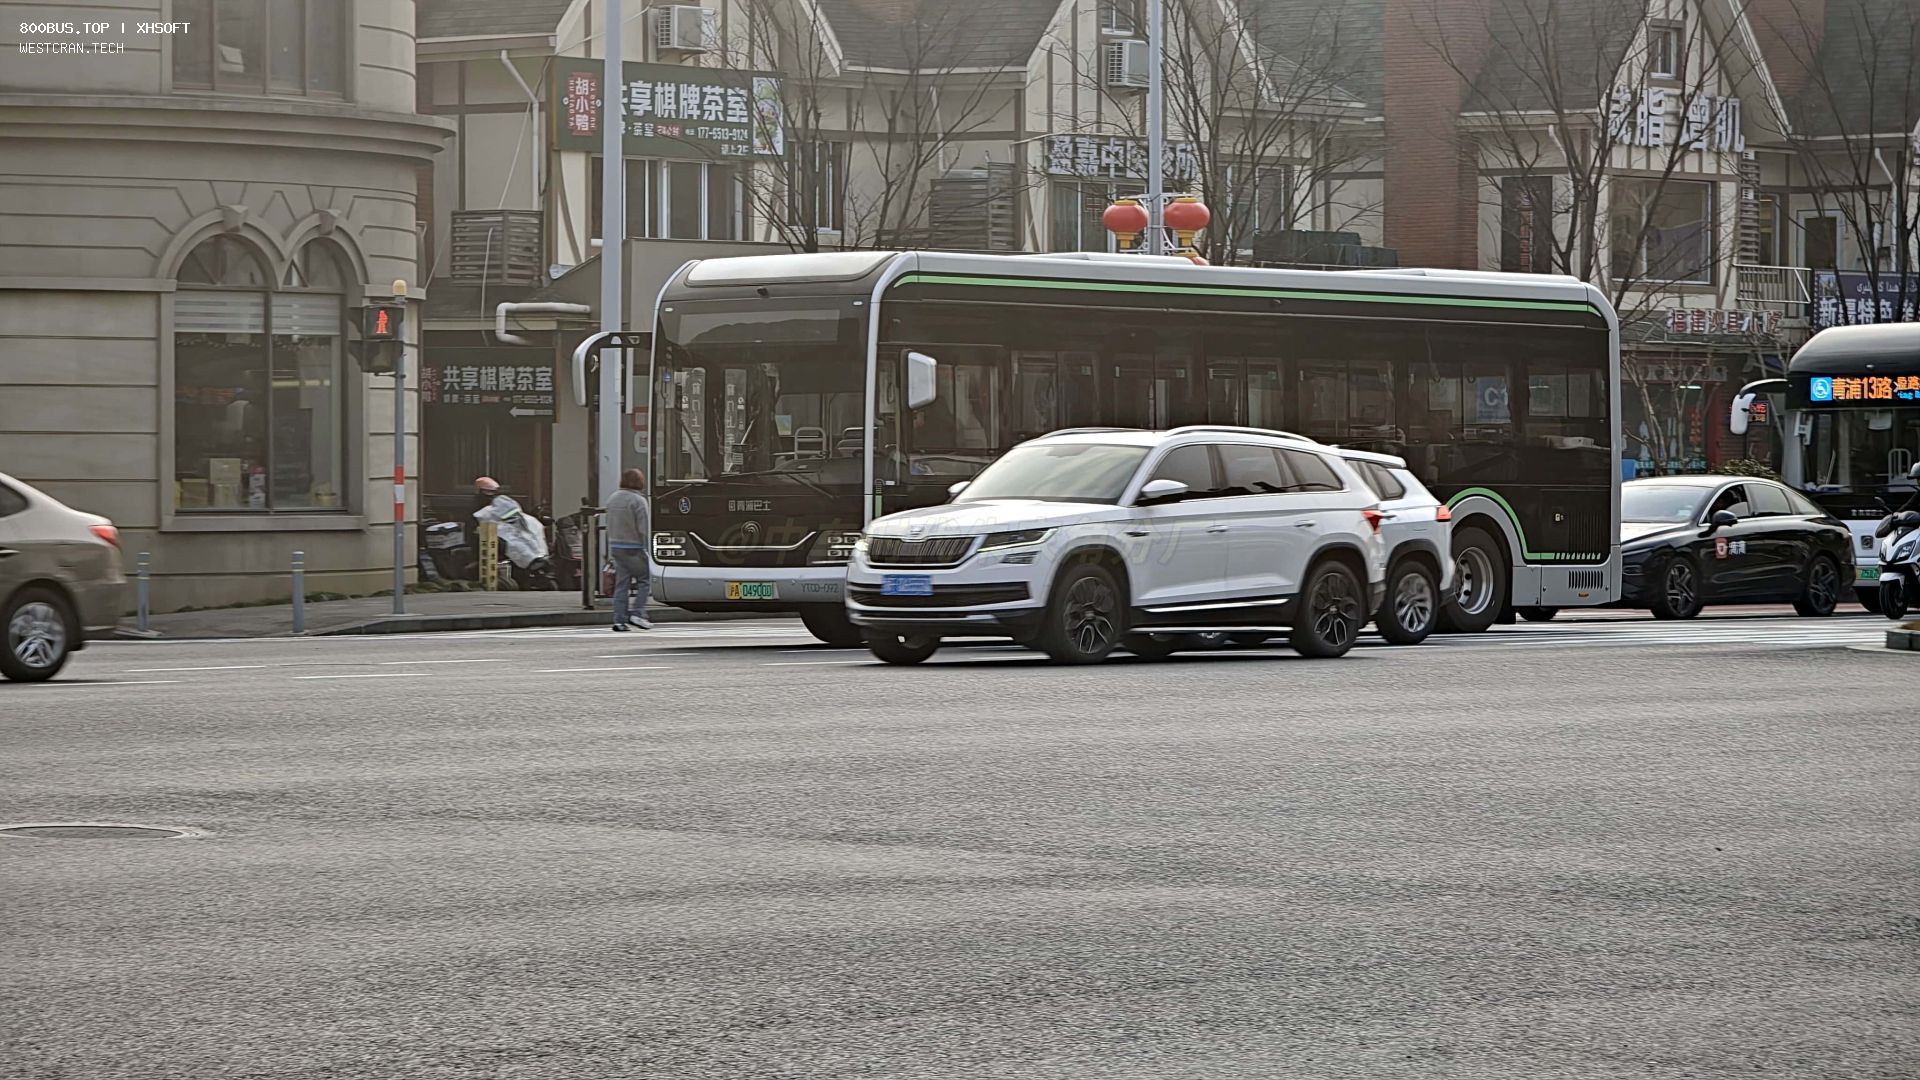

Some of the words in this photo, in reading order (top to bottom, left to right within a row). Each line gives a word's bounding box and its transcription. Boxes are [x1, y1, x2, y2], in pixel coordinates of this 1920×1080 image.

[575, 76, 589, 131] 胡小鸭
[443, 365, 553, 391] 共享棋牌茶室
[1832, 377, 1892, 400] 青浦13路
